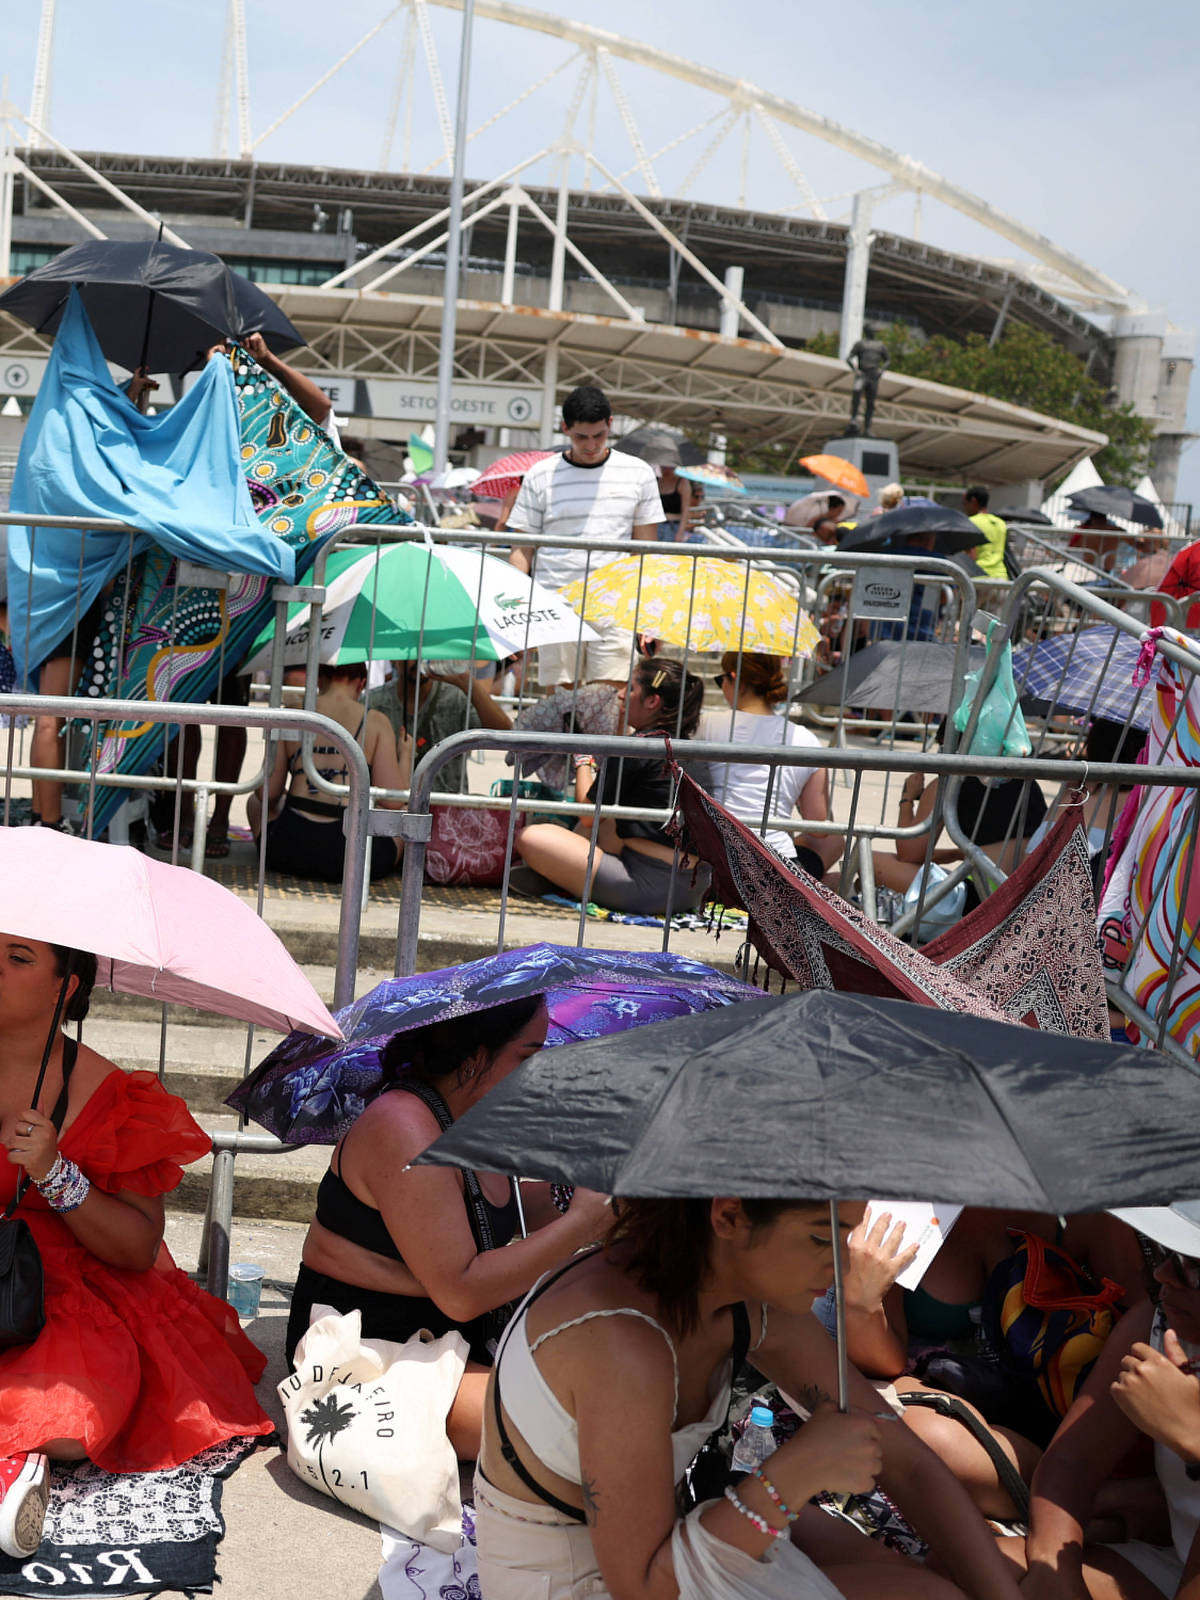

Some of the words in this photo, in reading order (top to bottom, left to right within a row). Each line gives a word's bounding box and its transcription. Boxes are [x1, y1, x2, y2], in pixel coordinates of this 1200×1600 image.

[400, 395, 438, 410] SETO
[450, 398, 497, 414] OESTE
[492, 608, 561, 630] LACOSTE
